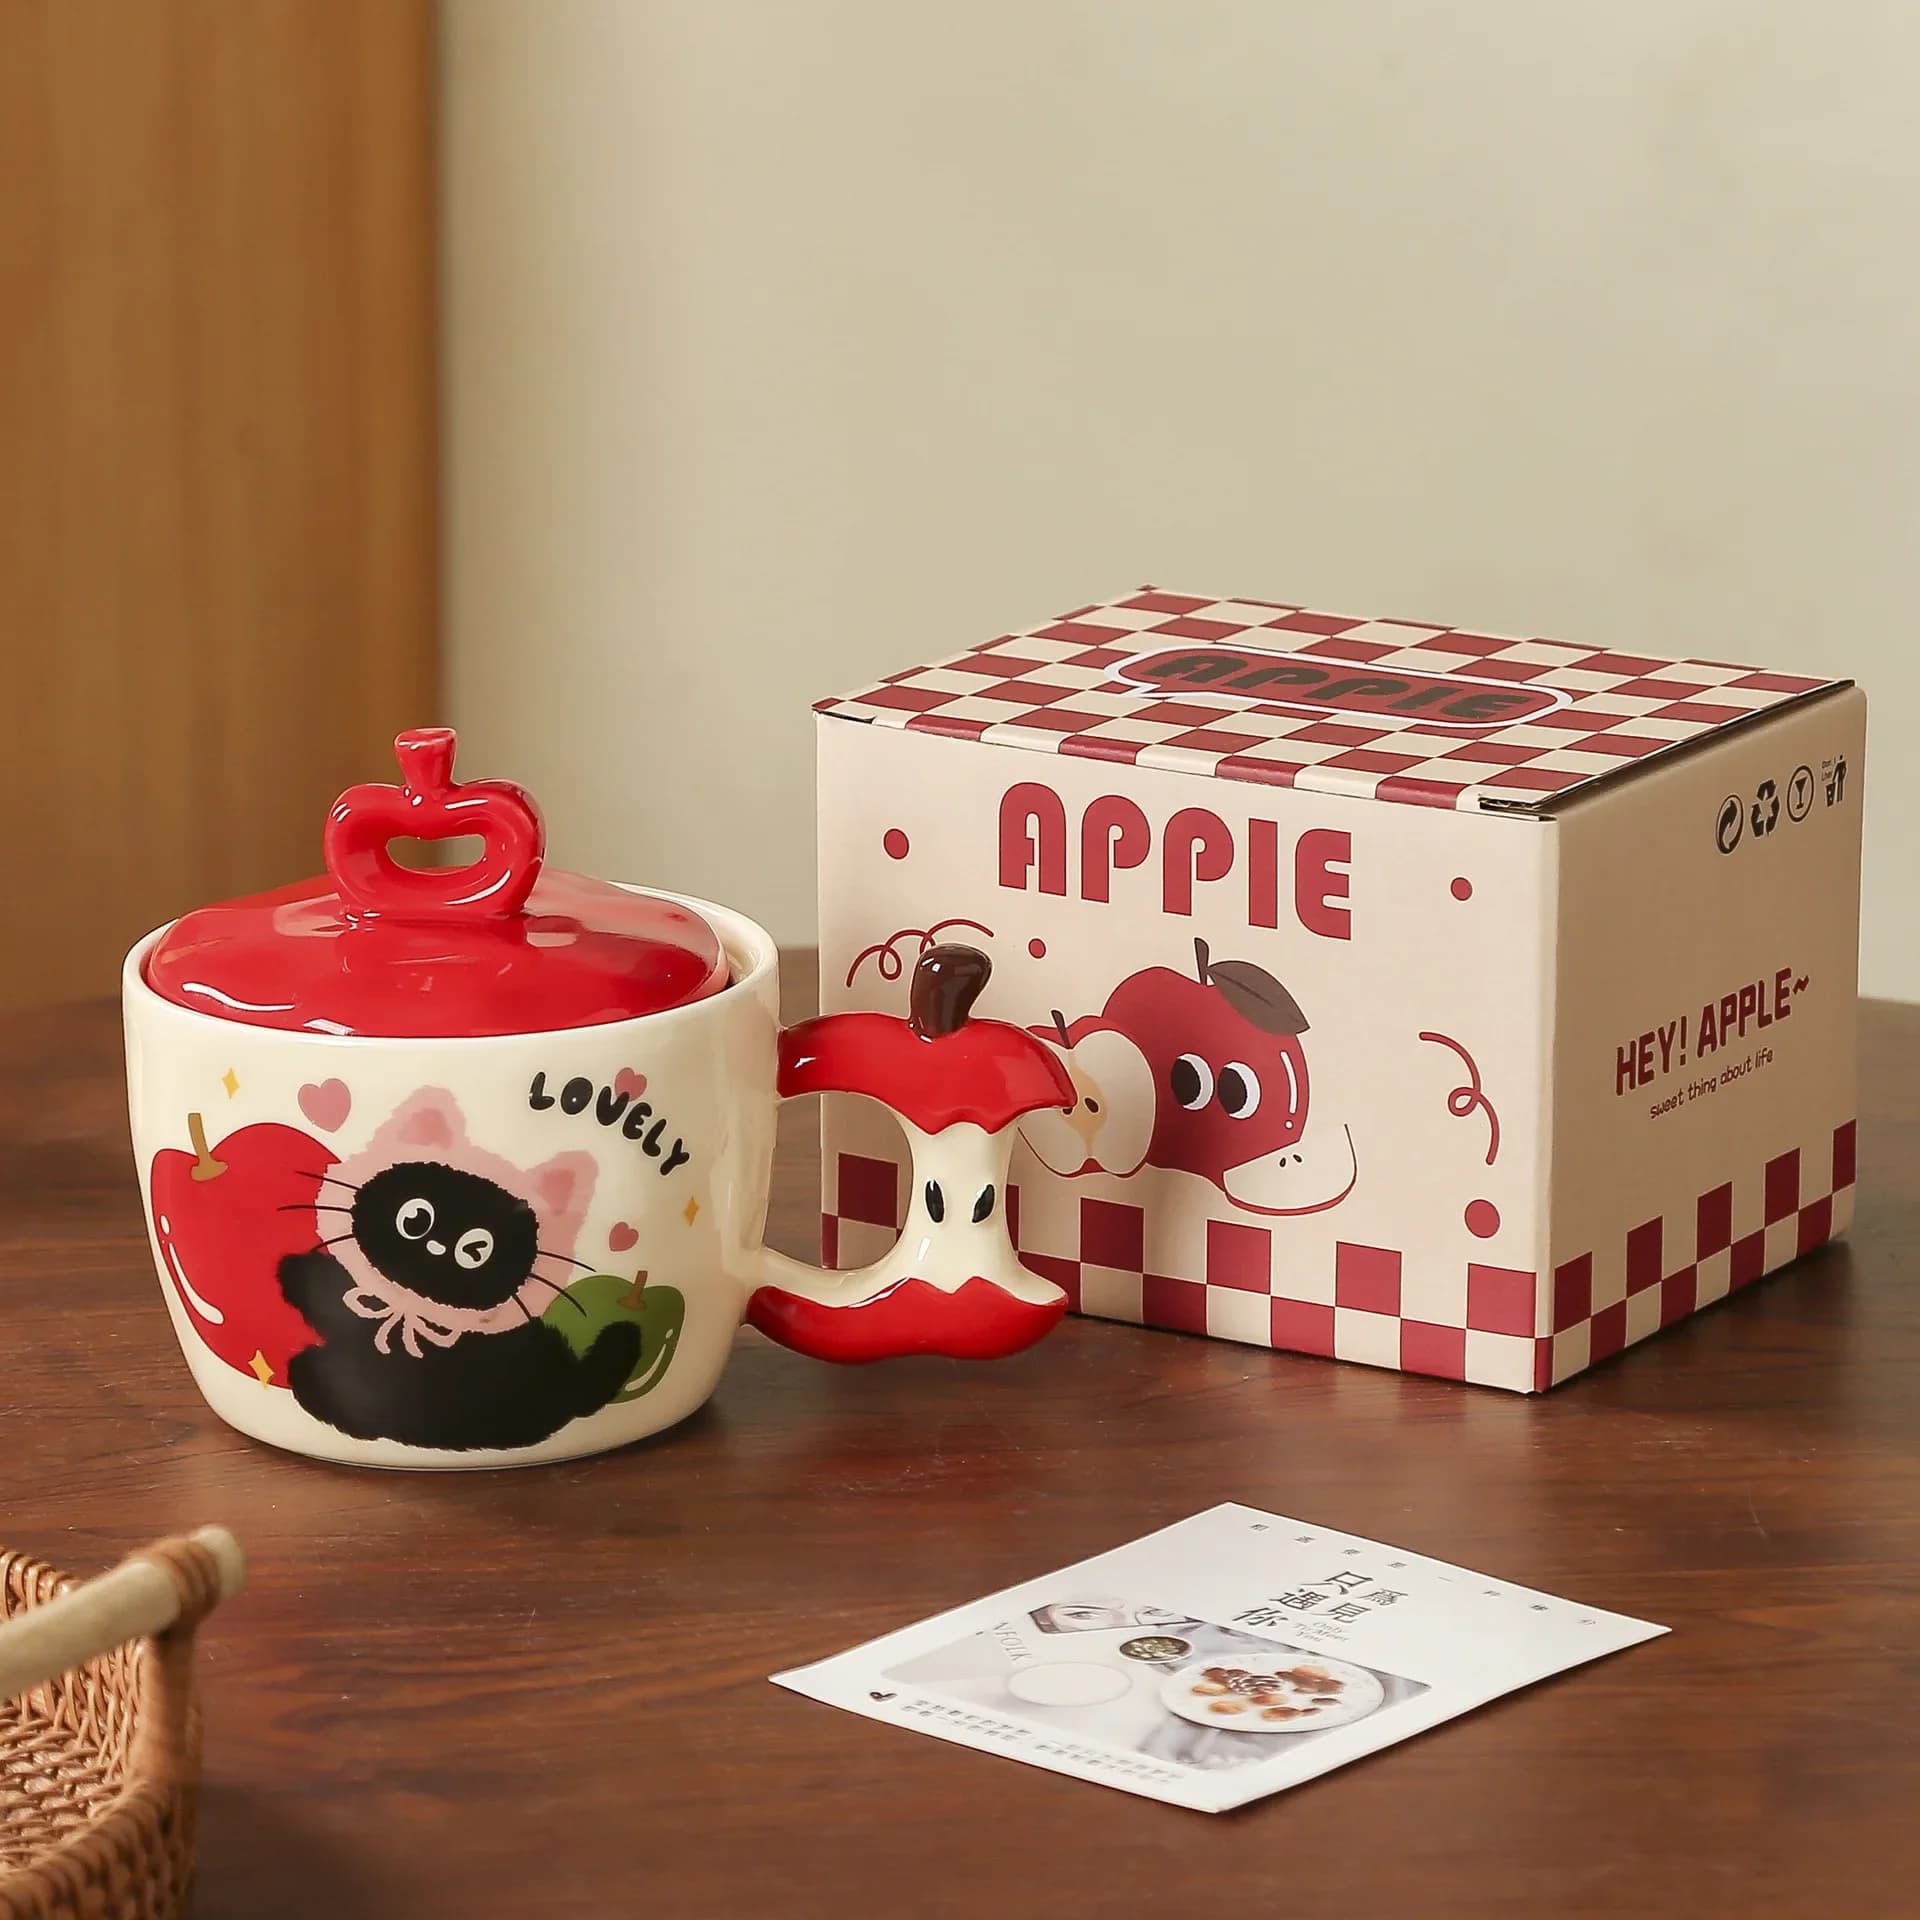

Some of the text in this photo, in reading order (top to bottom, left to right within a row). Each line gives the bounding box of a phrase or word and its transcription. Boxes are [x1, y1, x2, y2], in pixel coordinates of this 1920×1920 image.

[1616, 1015, 1687, 1096] HEY!
[1650, 1047, 1773, 1119] sweet thing about life
[528, 1071, 690, 1176] LOVELY
